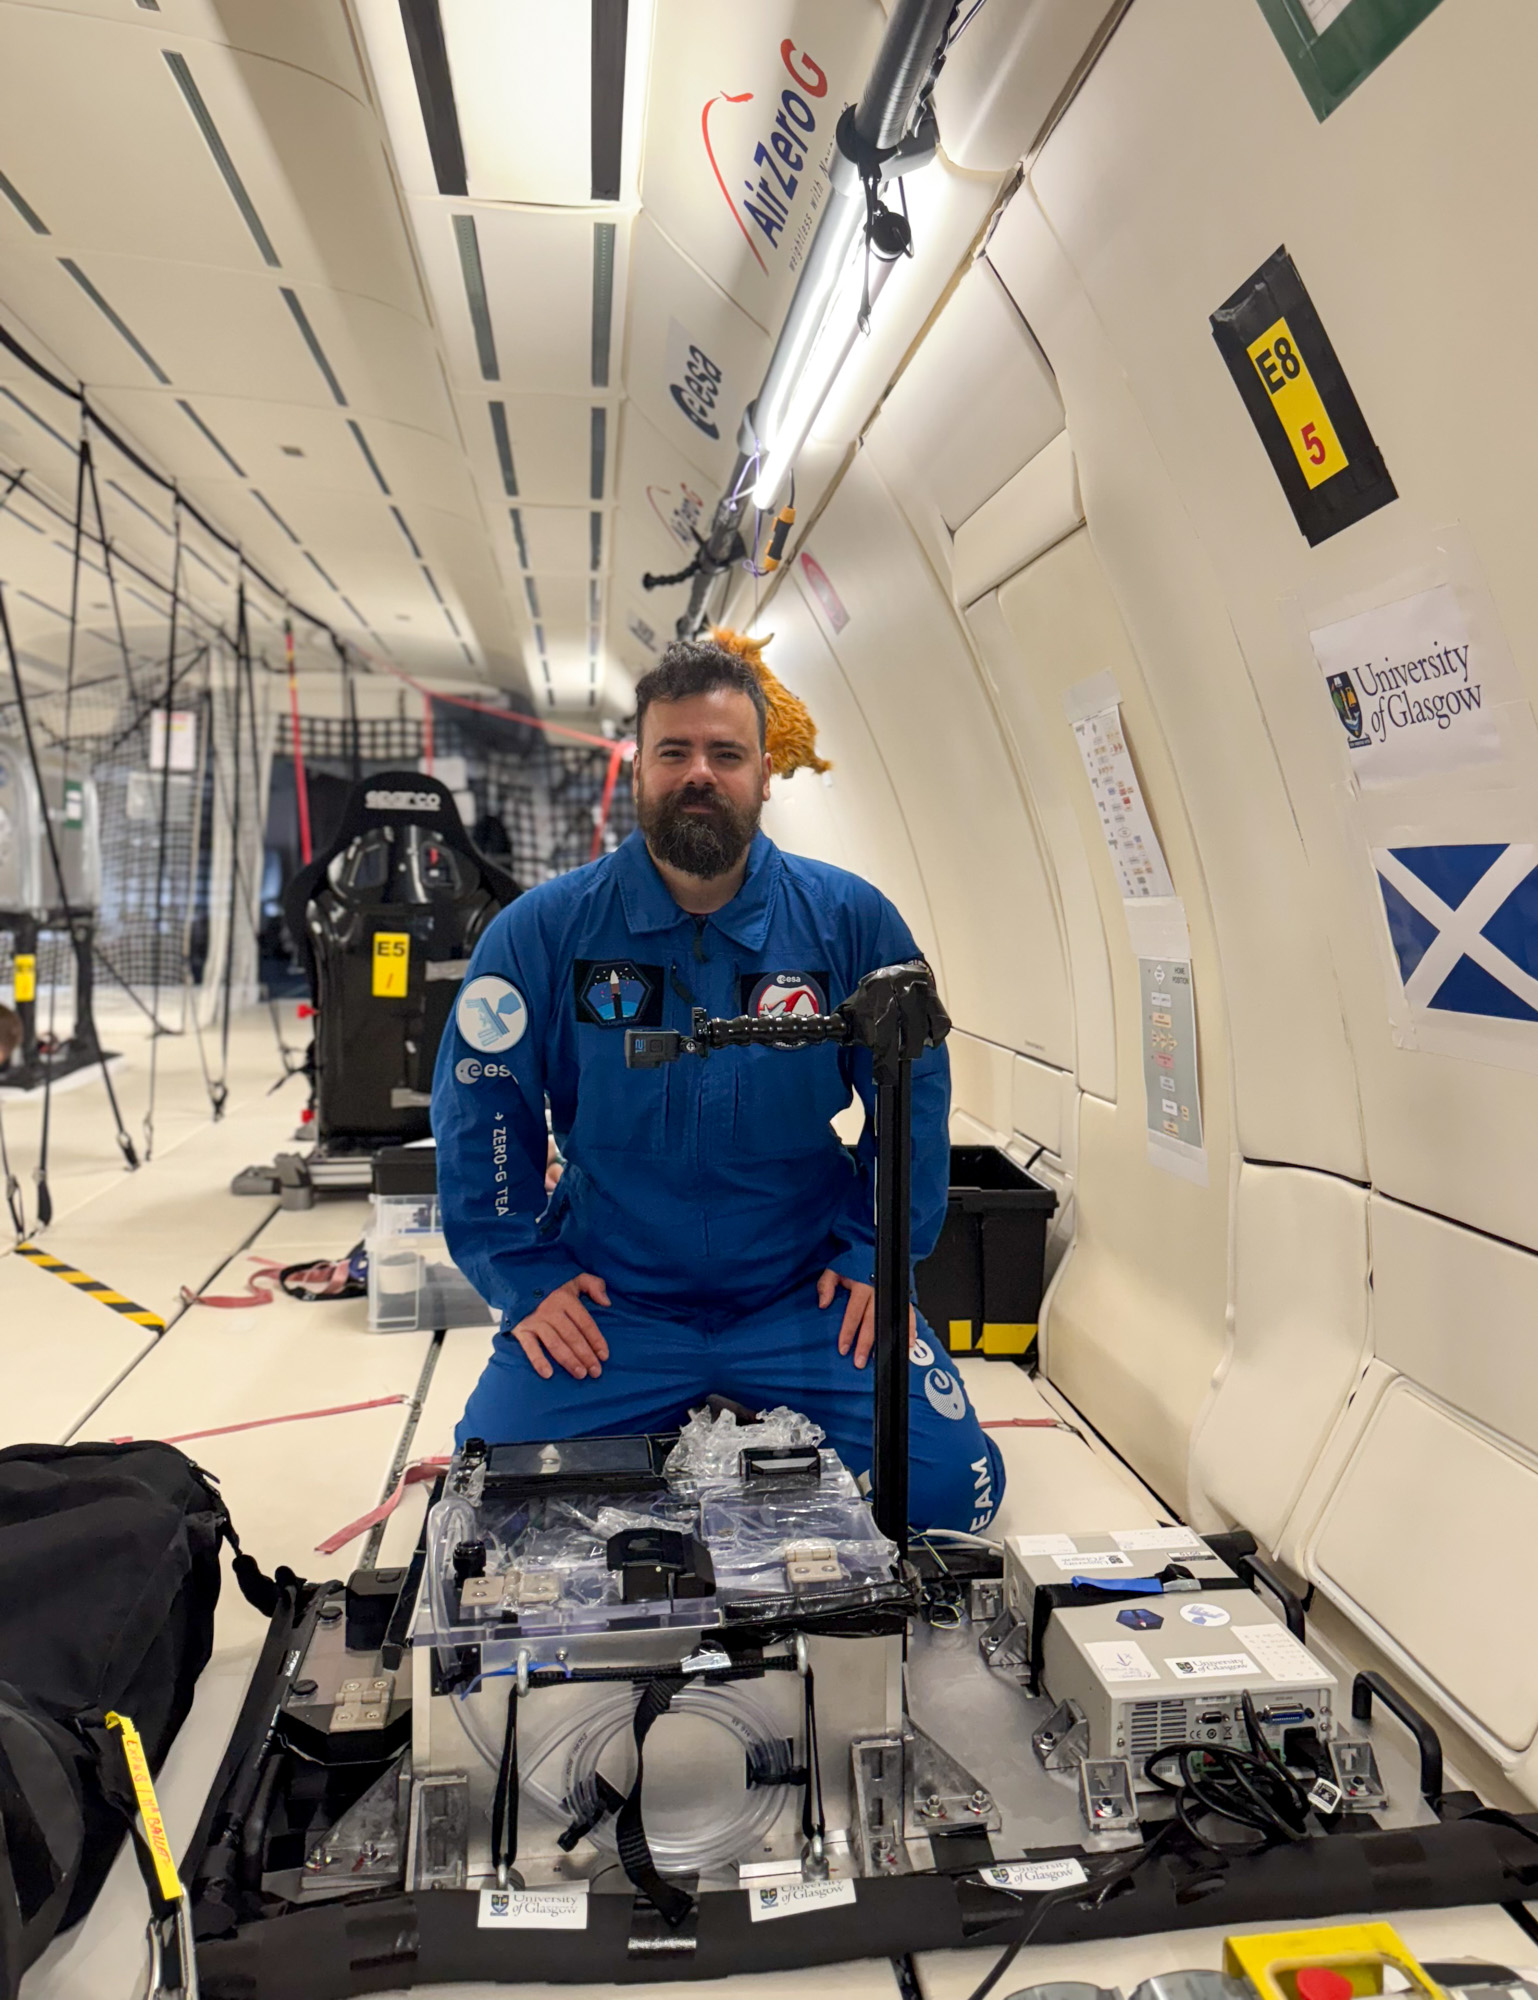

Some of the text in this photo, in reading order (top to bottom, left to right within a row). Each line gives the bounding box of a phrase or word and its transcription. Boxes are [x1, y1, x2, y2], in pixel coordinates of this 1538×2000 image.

[743, 38, 828, 250] AirZeroG
[788, 180, 825, 273] weightless with
[1255, 337, 1301, 395] E8
[1300, 421, 1326, 466] 5
[1352, 641, 1470, 697] University
[1371, 684, 1482, 742] of Glasgow
[376, 941, 406, 957] E5
[492, 1126, 512, 1217] ZERO-G TEA
[969, 1456, 994, 1534] EAM
[1192, 1659, 1244, 1667] University
[1010, 1862, 1071, 1873] University
[1014, 1868, 1074, 1882] of Glasgow
[512, 1902, 578, 1917] of Glasgow
[513, 1893, 578, 1905] University
[782, 1885, 844, 1905] of Glasgow
